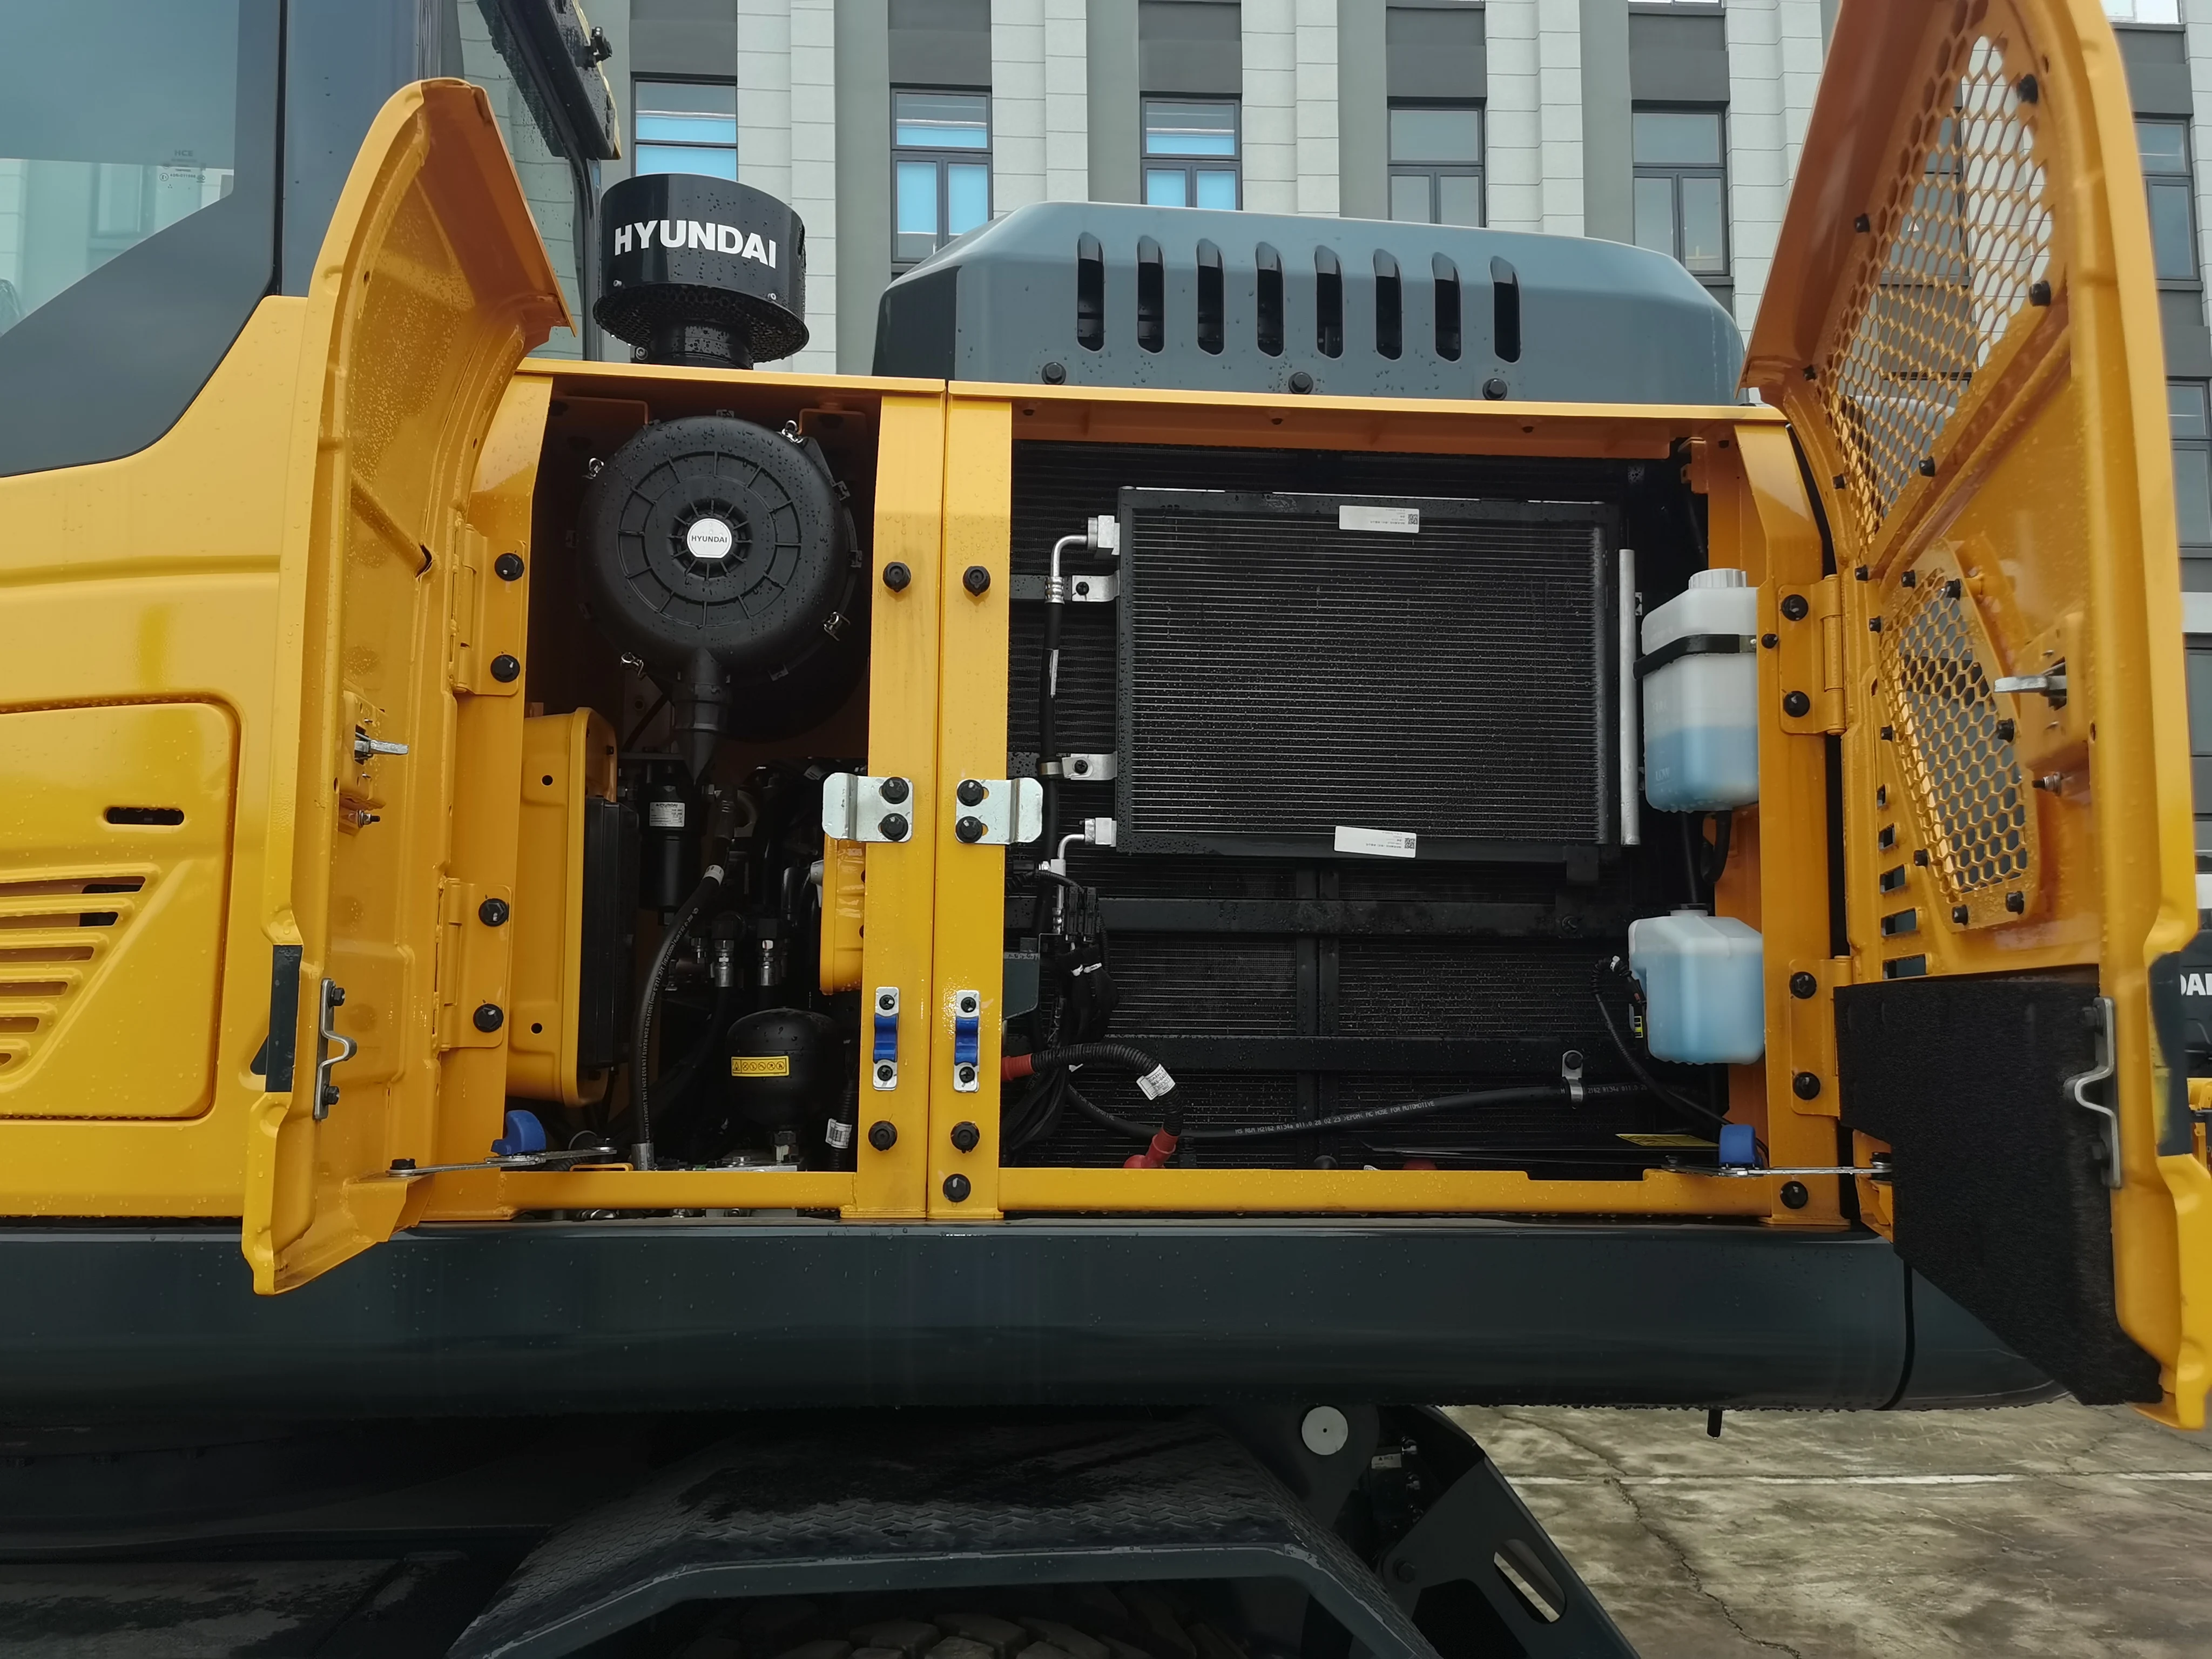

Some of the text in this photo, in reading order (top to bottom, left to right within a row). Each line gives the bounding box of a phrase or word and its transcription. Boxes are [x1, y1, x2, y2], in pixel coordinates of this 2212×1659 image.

[615, 219, 777, 269] HYUNDAI
[691, 535, 727, 543] HYUNDAI
[1402, 1101, 1435, 1110] AUTOMOTIVE
